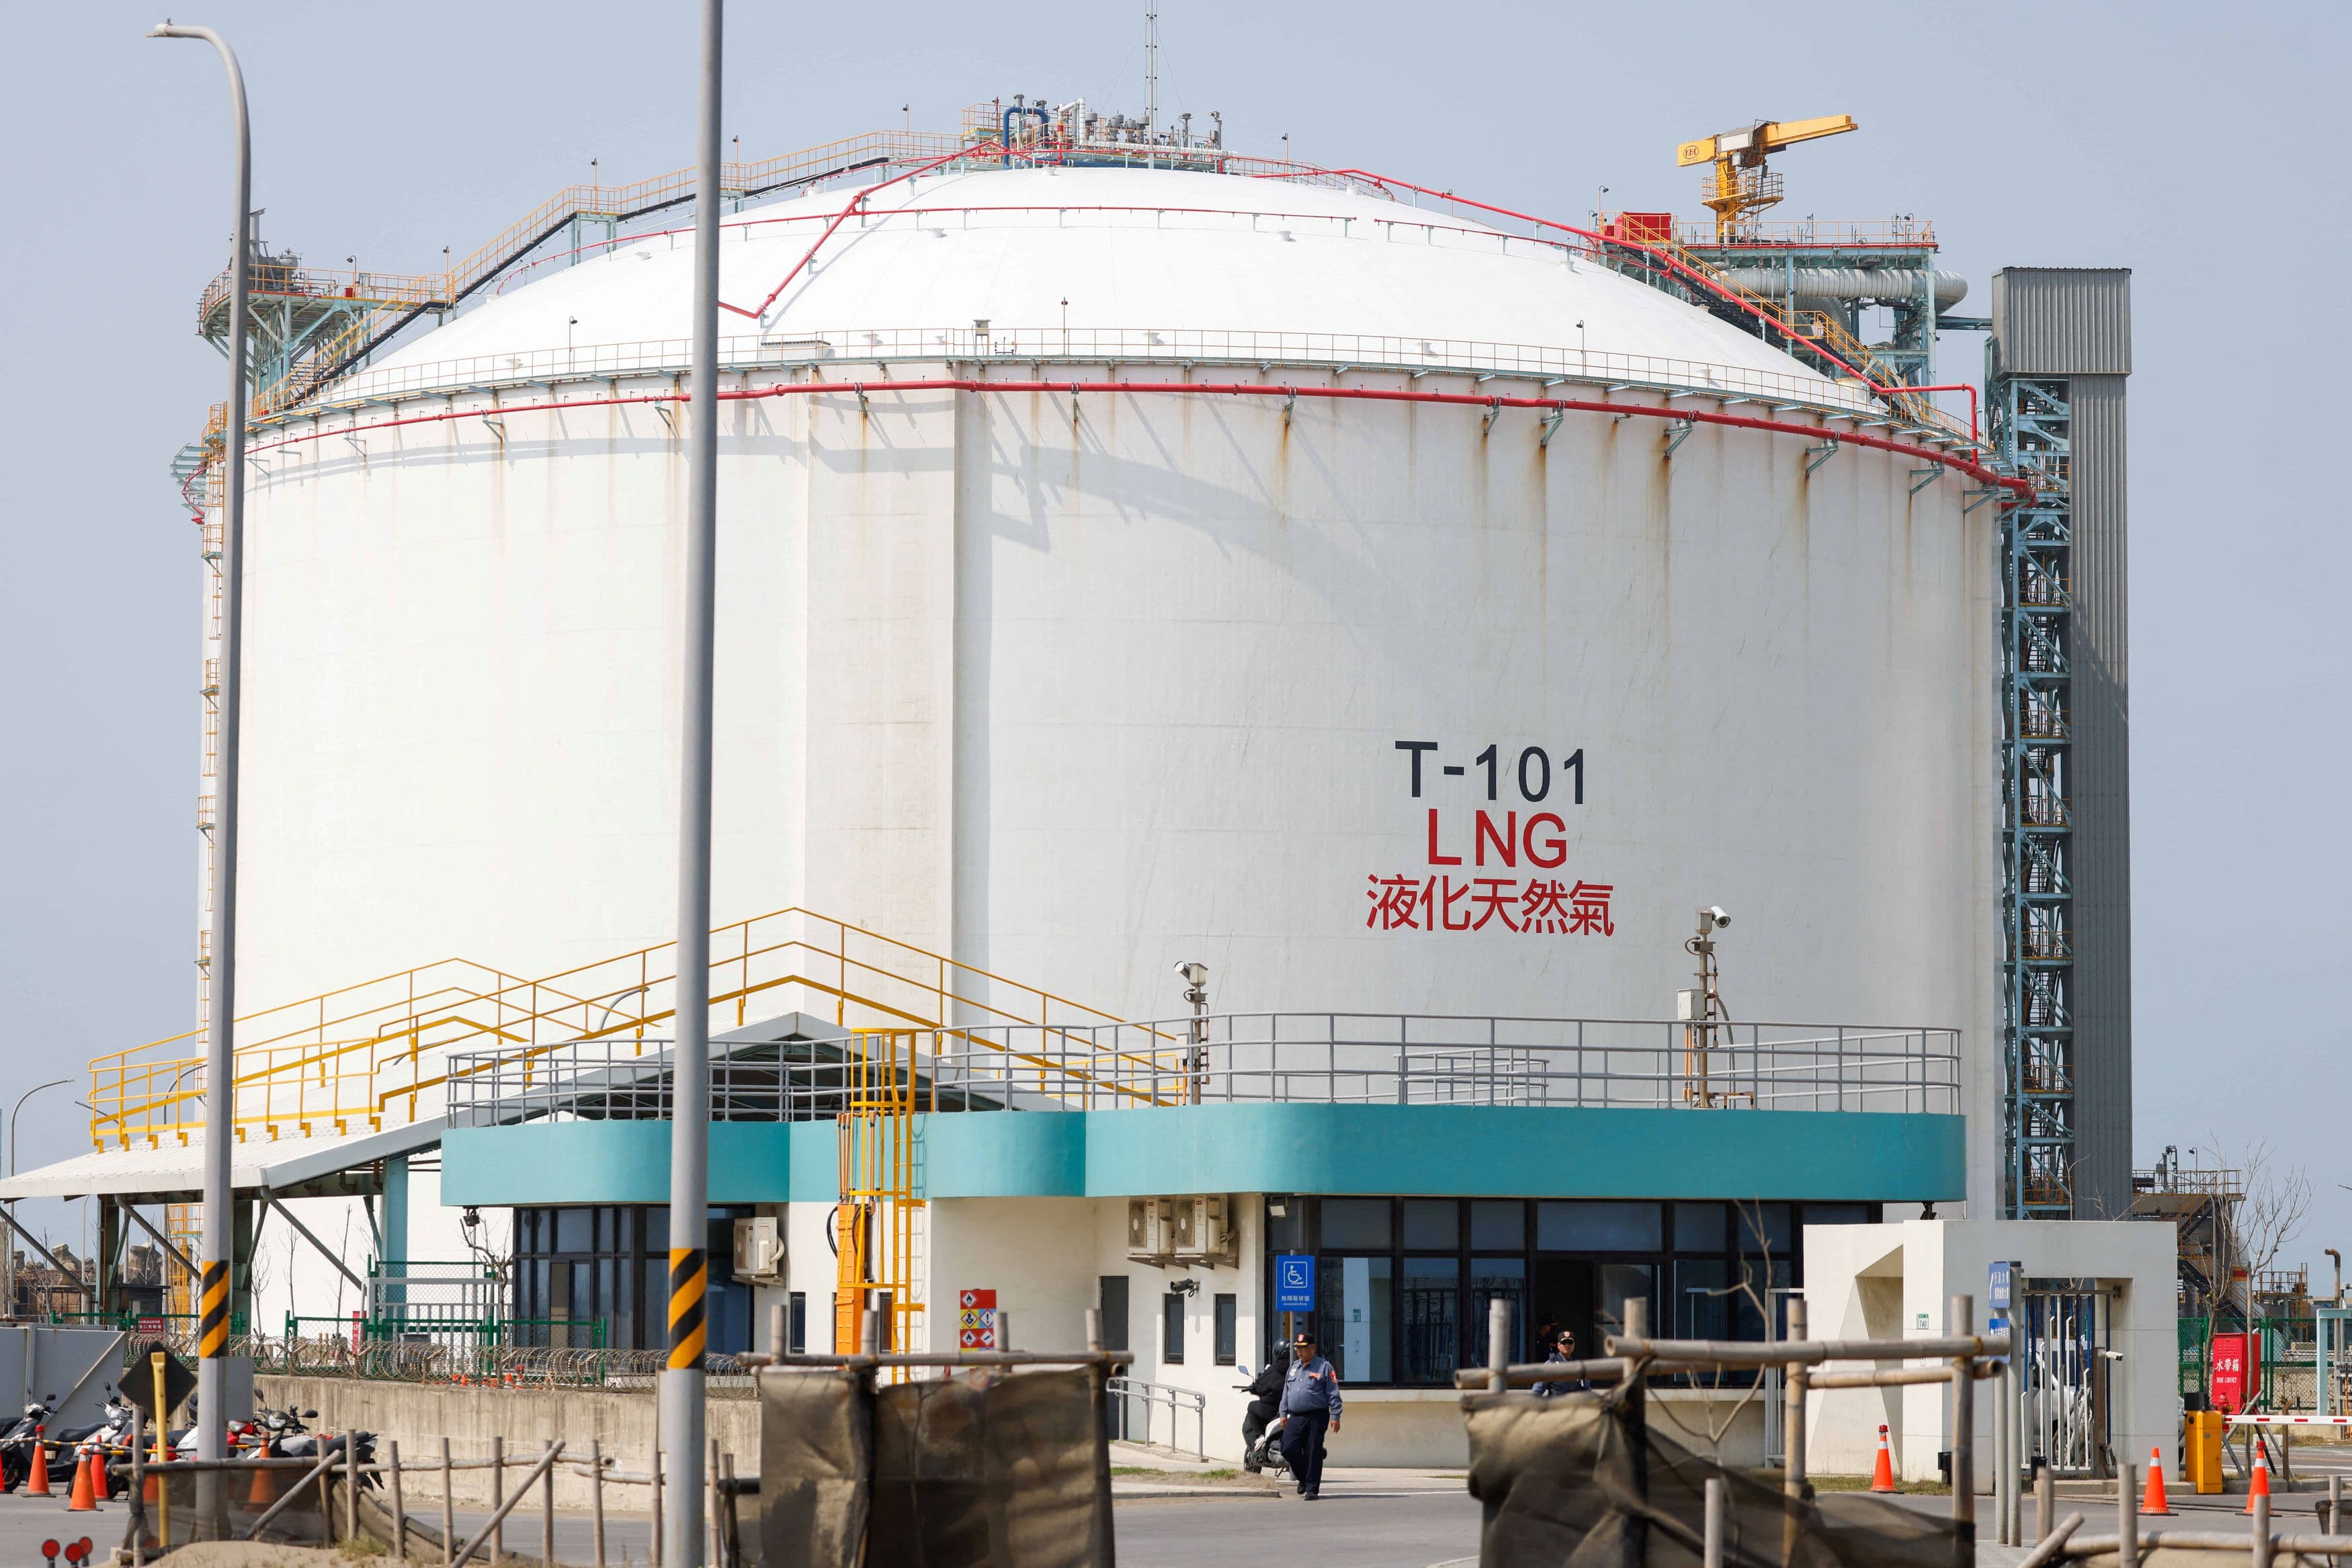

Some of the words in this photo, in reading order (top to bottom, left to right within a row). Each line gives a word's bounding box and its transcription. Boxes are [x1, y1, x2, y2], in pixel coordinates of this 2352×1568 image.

[1395, 740, 1584, 804] T-101
[1428, 808, 1567, 869] LNG
[1366, 873, 1615, 937] 液化天然氣
[2214, 1358, 2239, 1373] 水帶箱
